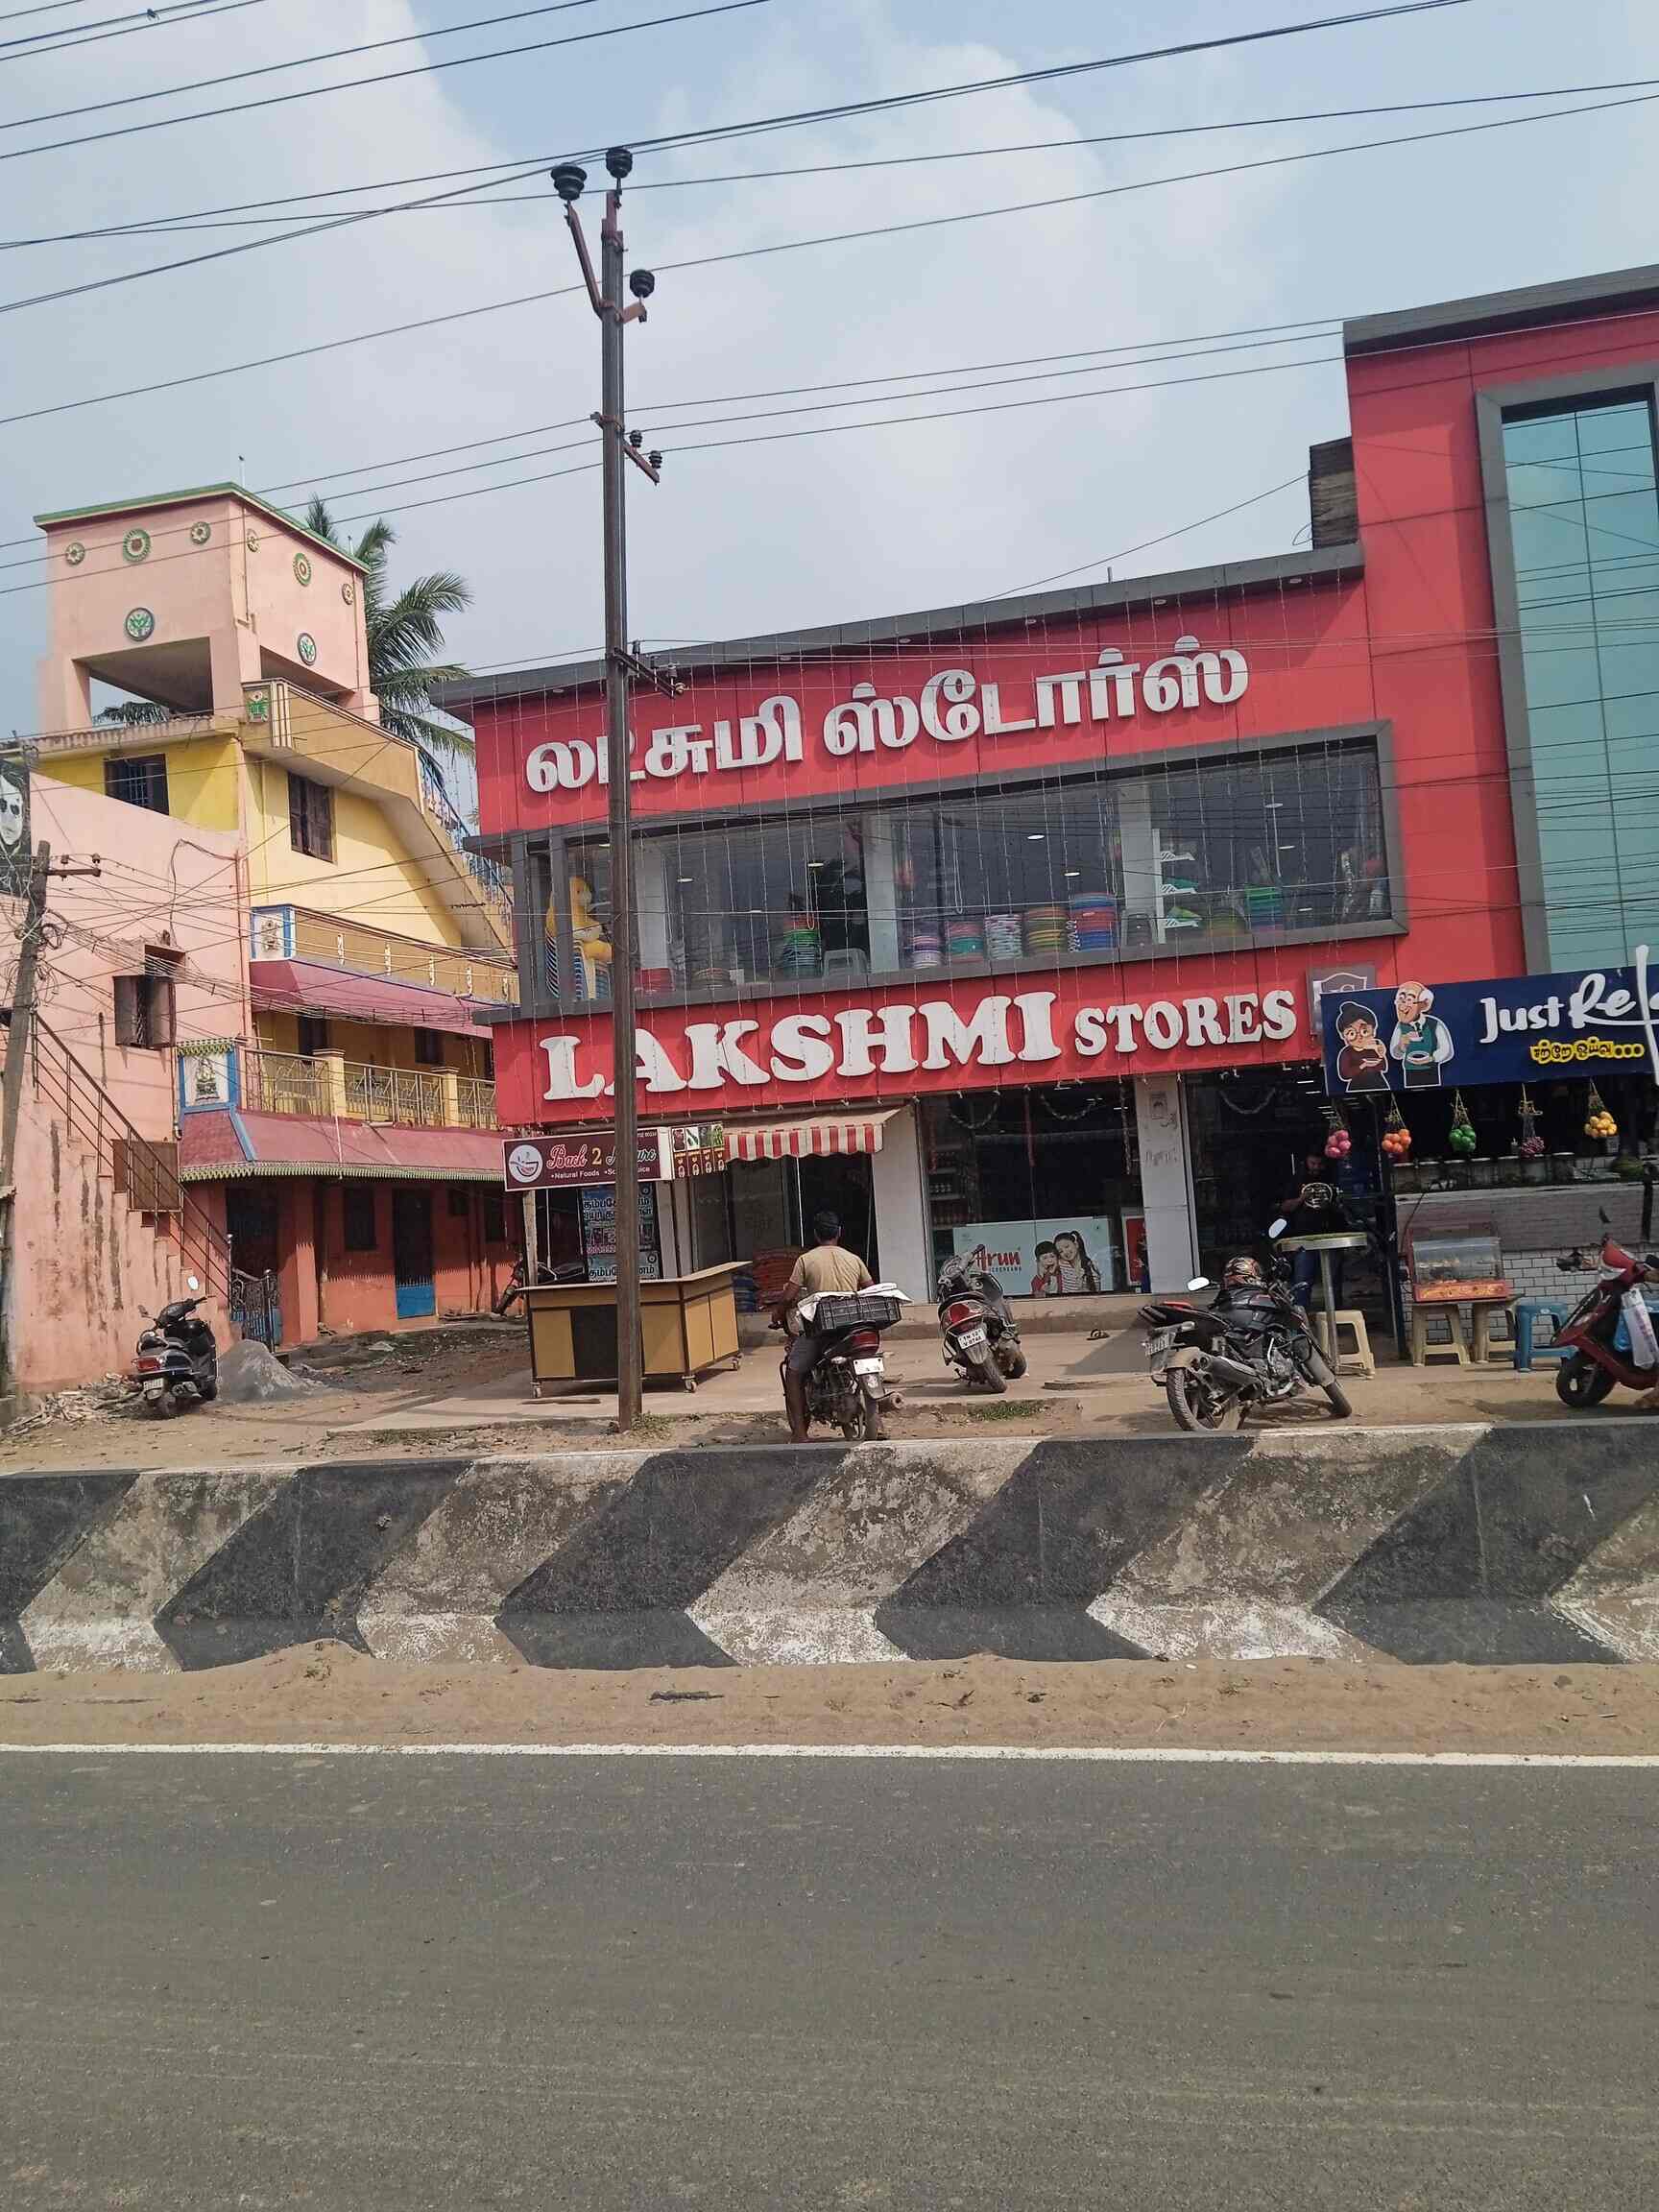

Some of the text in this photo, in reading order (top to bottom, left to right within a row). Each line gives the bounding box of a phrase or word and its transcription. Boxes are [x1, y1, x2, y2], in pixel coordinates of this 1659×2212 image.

[824, 635, 1249, 757] ஸ்டோர்ஸ்
[1479, 997, 1565, 1044] Just
[539, 990, 1297, 1100] LAKSHMI STORES
[546, 1143, 588, 1169] Back
[591, 1147, 602, 1166] 2
[975, 1249, 1021, 1271] Arun
